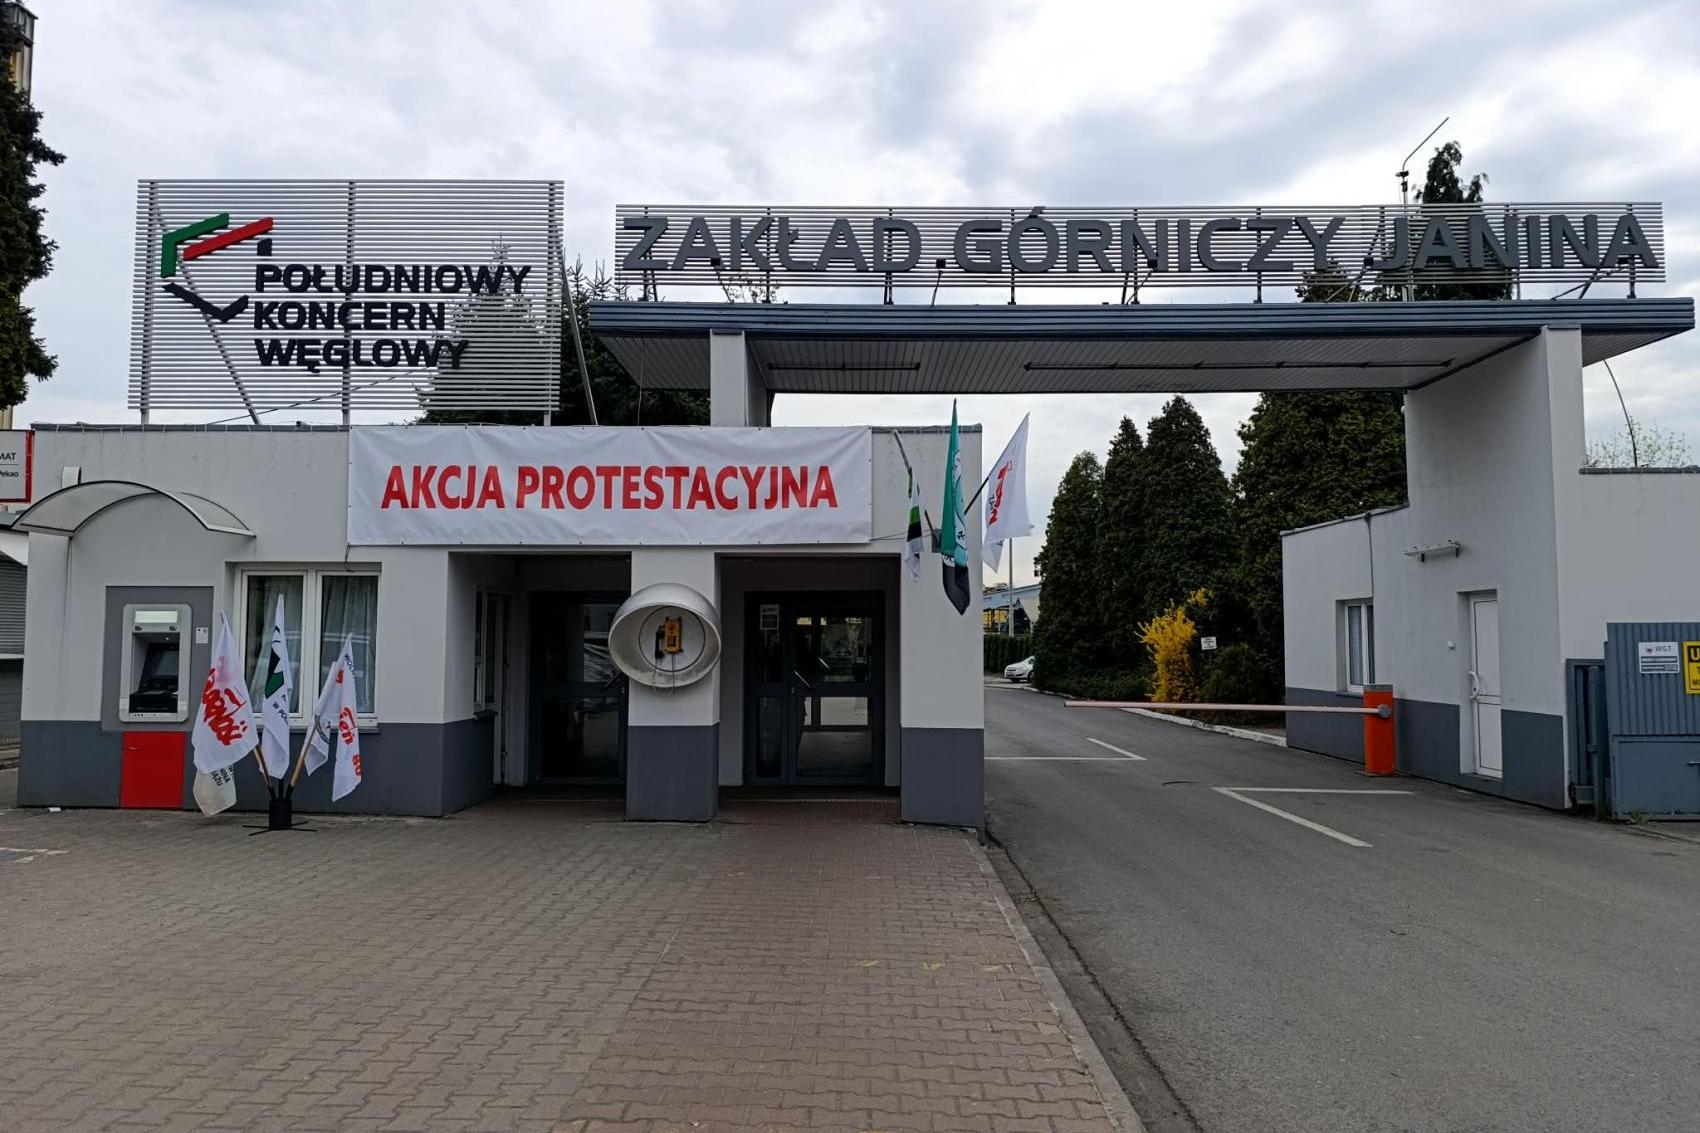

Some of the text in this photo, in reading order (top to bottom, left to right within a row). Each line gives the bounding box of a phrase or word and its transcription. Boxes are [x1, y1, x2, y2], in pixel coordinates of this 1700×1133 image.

[622, 206, 1661, 274] ZAKŁAD GÓRNICZY JANINA
[255, 264, 532, 294] POŁUDNIOWY
[254, 301, 445, 331] KONCERN
[254, 338, 469, 373] WĘGLOWY
[380, 465, 839, 511] AKCJA PROTESTACYJNA
